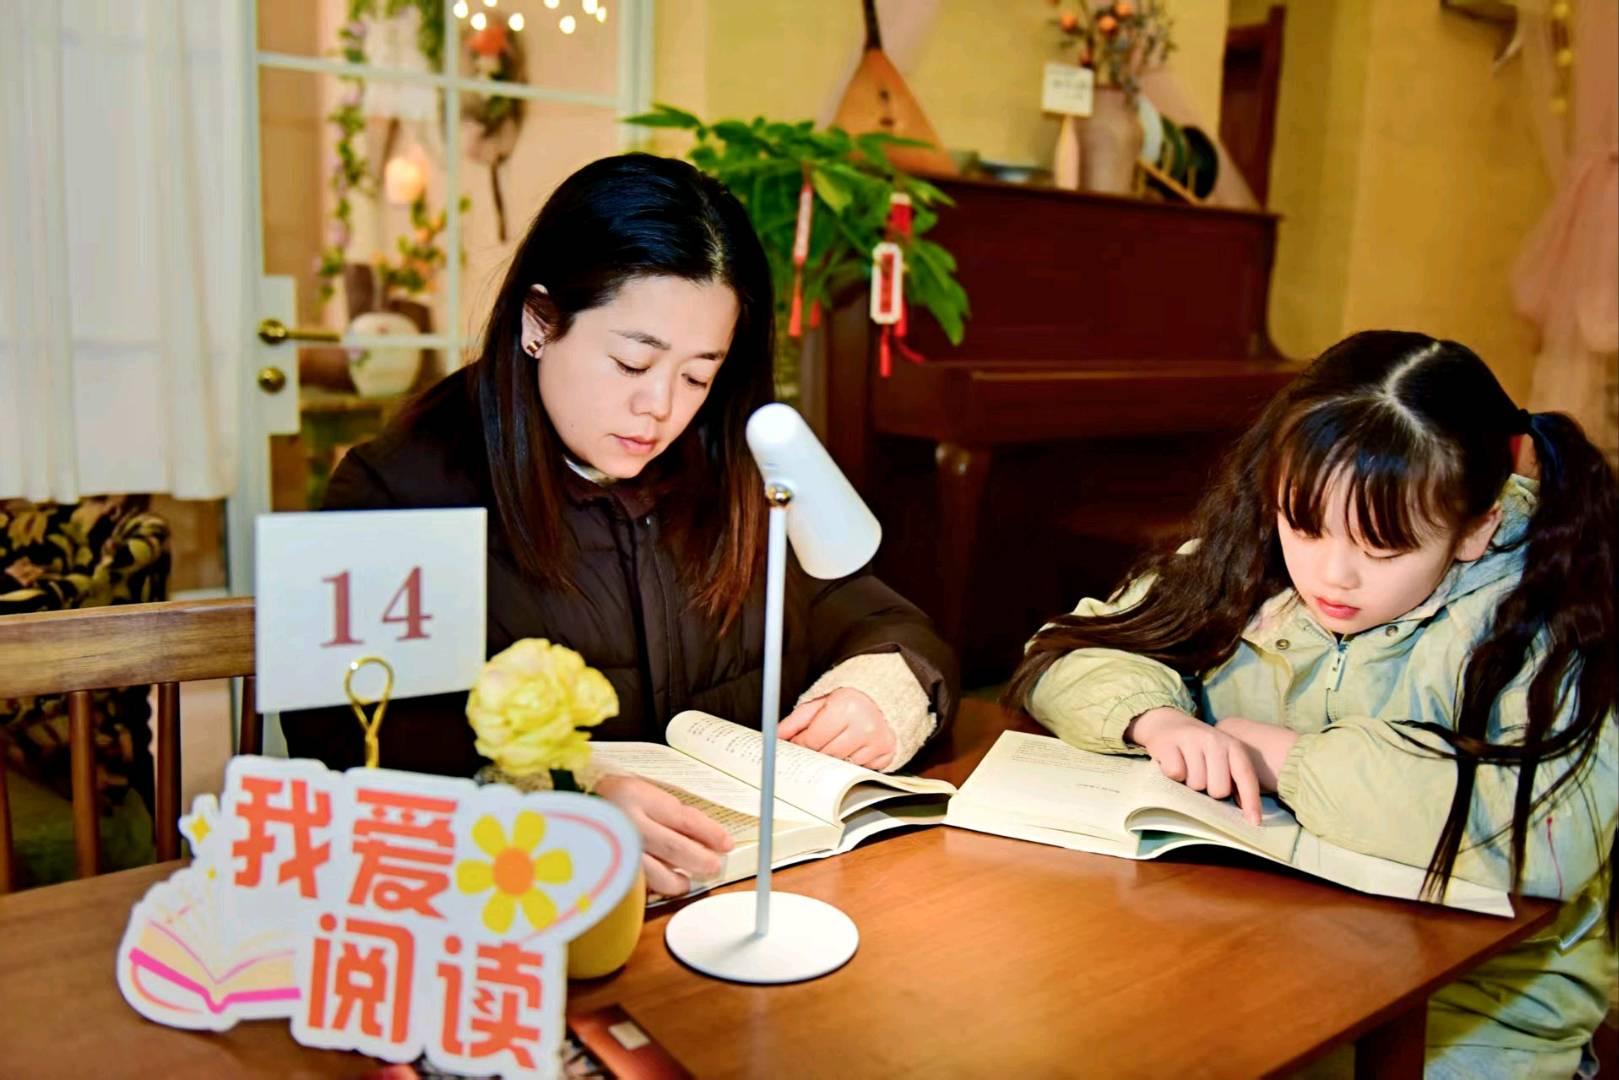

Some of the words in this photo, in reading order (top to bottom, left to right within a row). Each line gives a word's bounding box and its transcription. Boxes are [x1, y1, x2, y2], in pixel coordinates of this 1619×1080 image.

[320, 566, 433, 647] 14
[231, 776, 458, 919] 我爱
[308, 913, 543, 1070] 阅读
